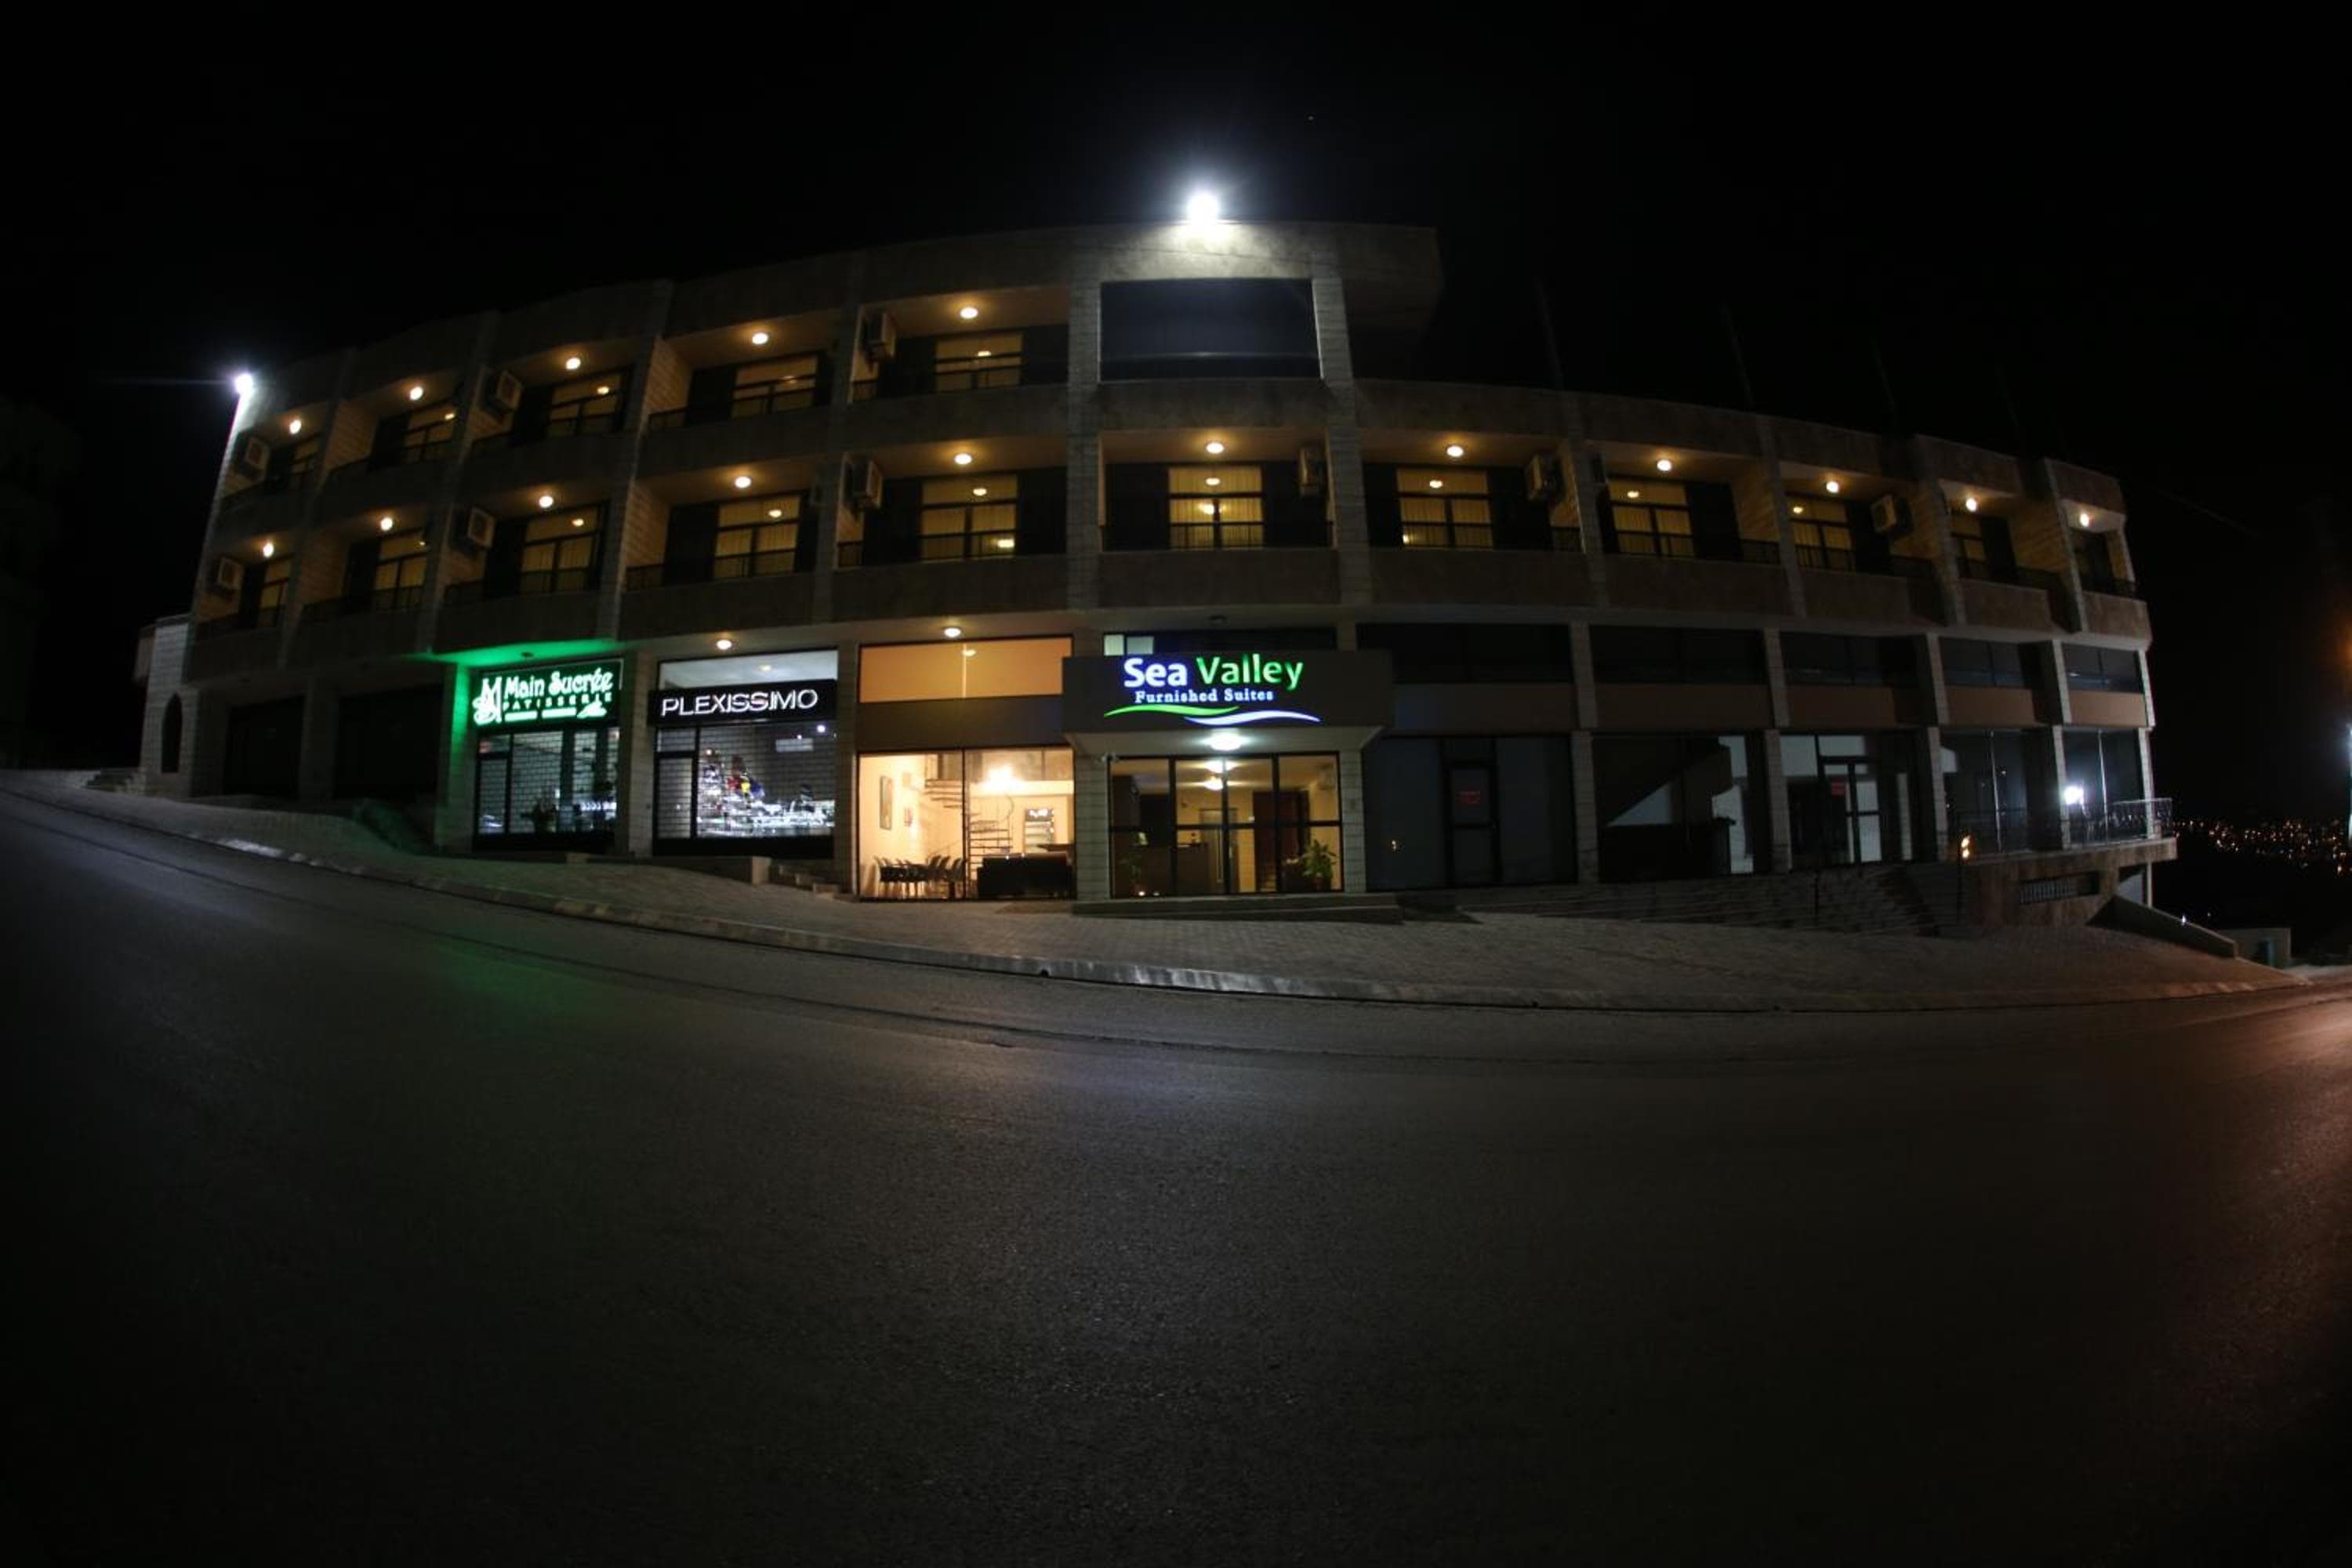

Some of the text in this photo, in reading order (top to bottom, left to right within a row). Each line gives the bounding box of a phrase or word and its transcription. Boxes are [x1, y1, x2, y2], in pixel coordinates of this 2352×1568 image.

[1123, 654, 1303, 690] Sea Valley
[504, 677, 544, 698] Main
[1134, 688, 1274, 703] Furnished Suites
[662, 688, 818, 717] PLEXISSIMO
